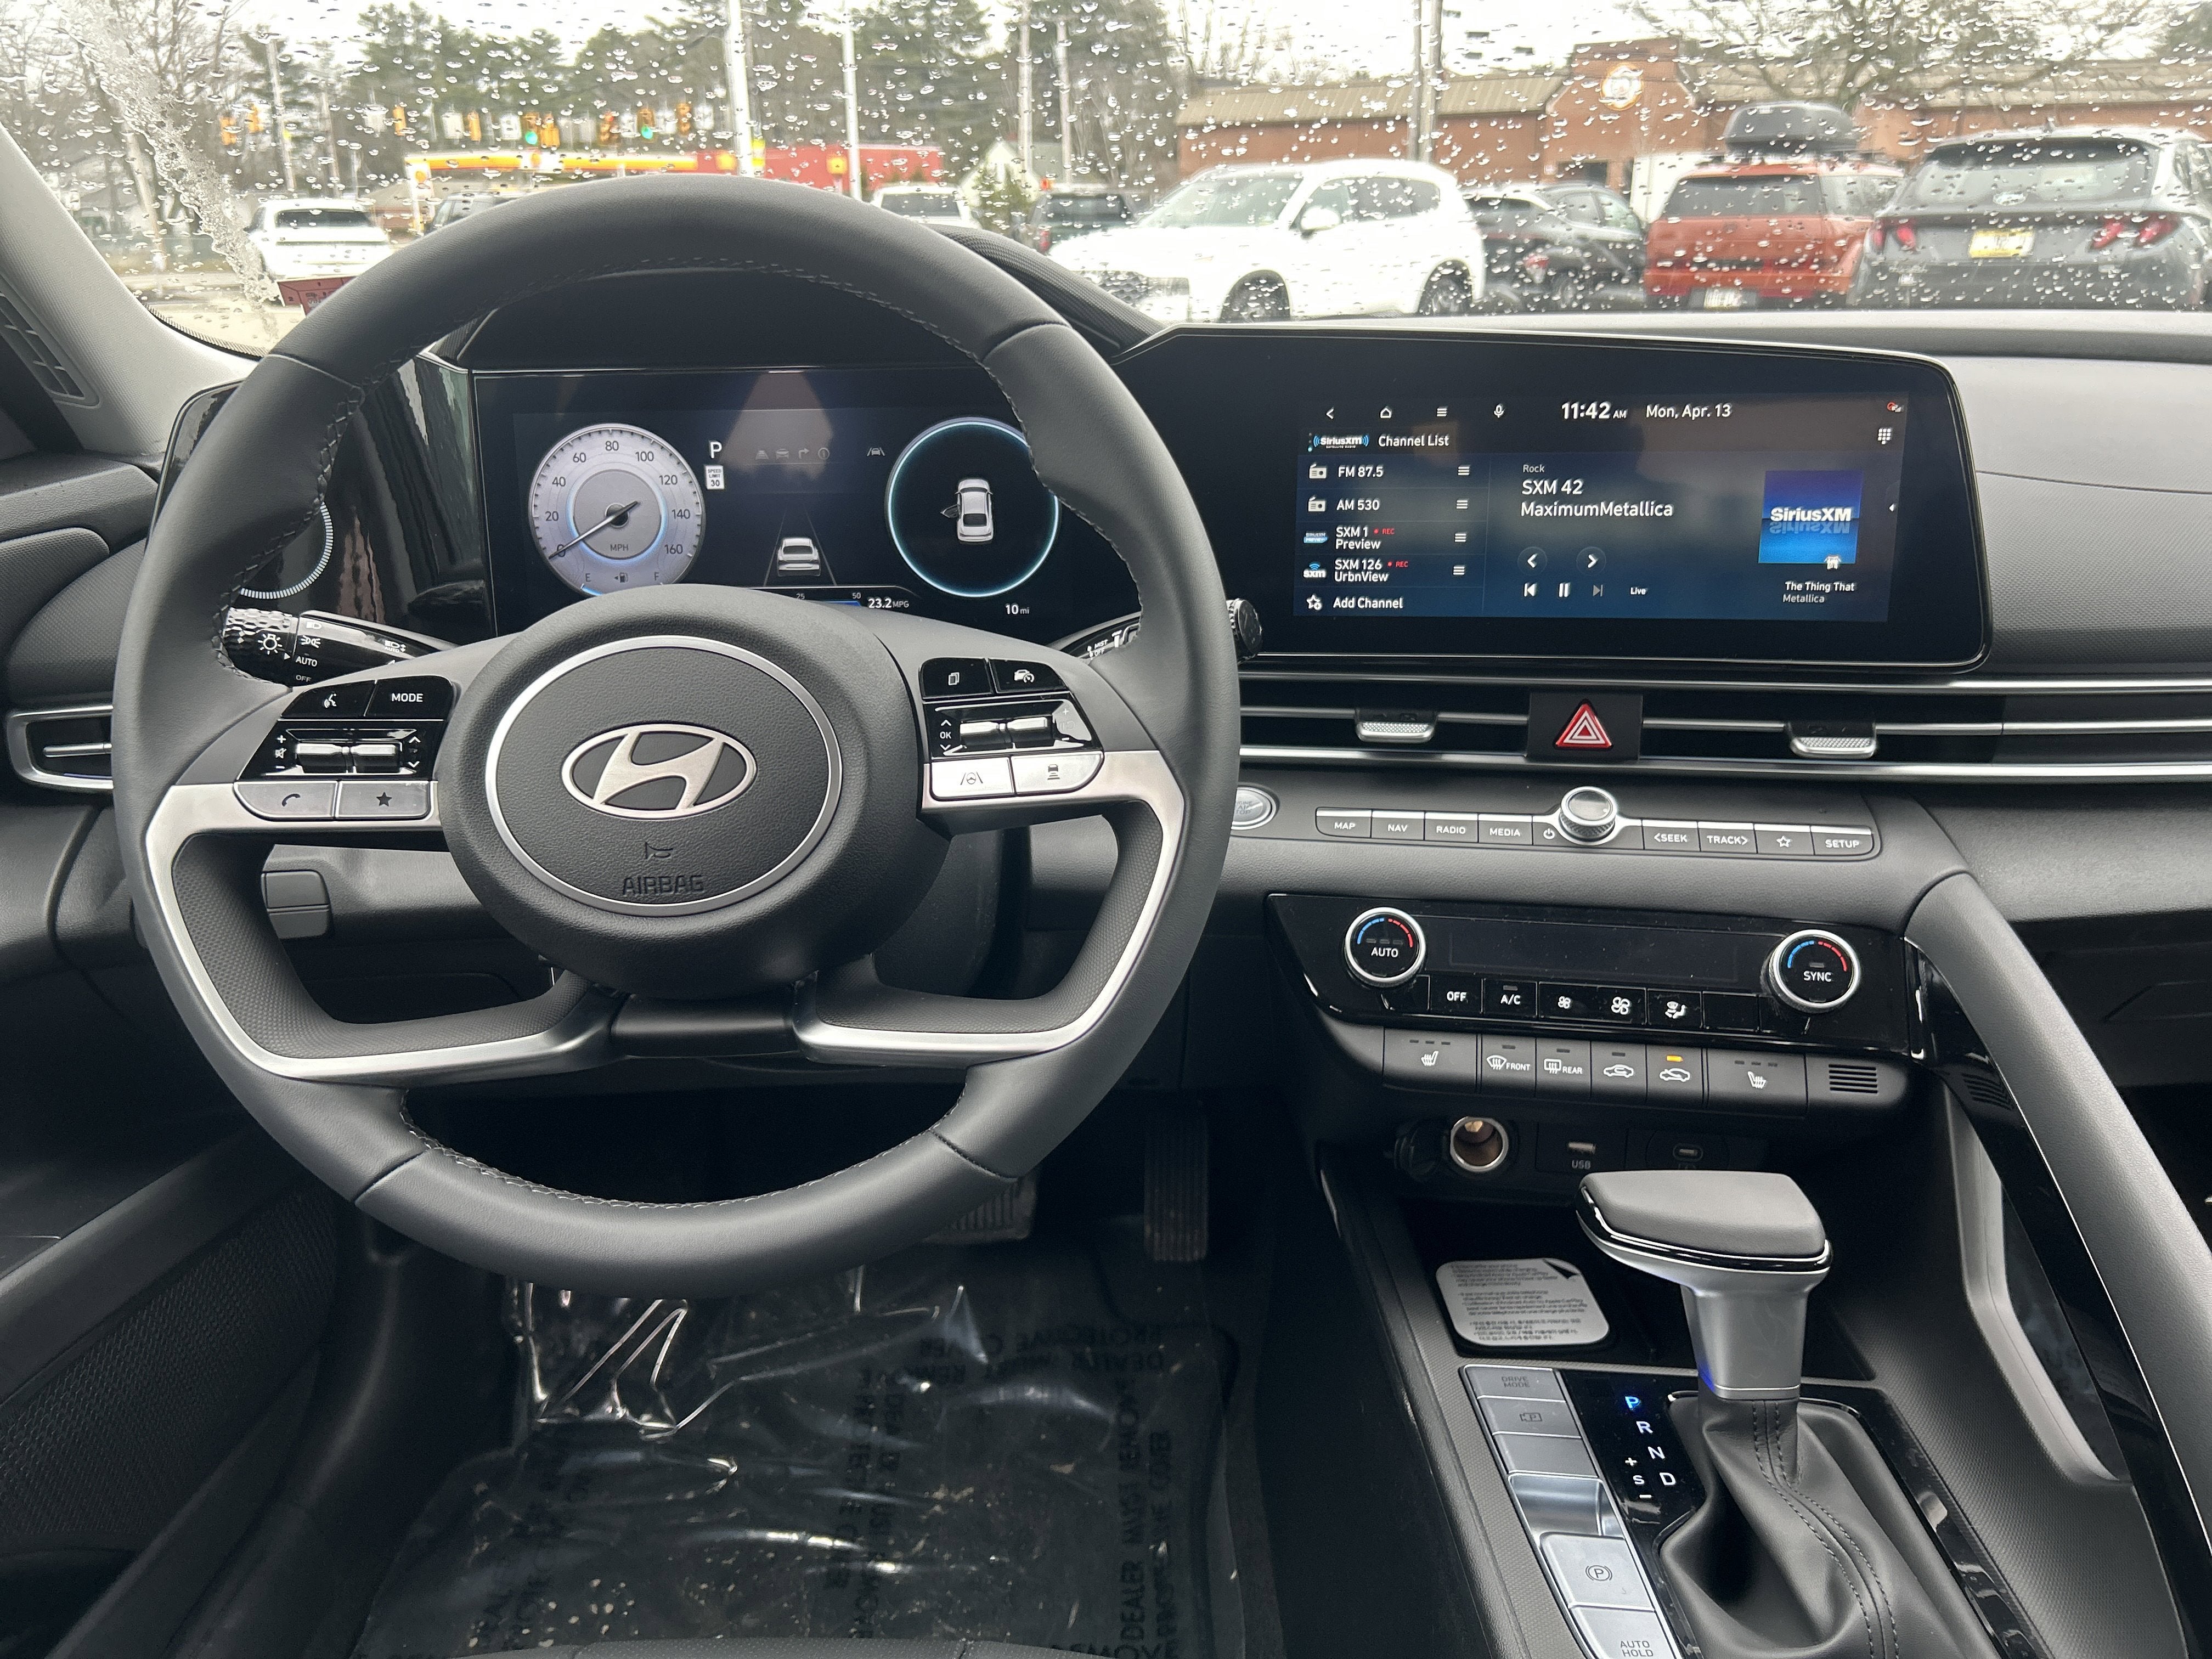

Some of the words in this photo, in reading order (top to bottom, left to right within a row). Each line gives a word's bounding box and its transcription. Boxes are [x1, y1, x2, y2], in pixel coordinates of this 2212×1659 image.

[1561, 402, 1611, 419] 11:42
[1612, 410, 1628, 419] AM
[1646, 404, 1679, 419] Mon,
[1681, 404, 1711, 421] Apr.
[1715, 403, 1733, 417] 13
[605, 441, 619, 452] 80
[1378, 435, 1425, 447] Channel
[1427, 435, 1449, 447] List
[710, 441, 722, 459] P
[572, 452, 586, 463] 60
[635, 451, 654, 462] 100
[1338, 466, 1356, 478] FM
[1357, 466, 1384, 478] 87.5
[1522, 464, 1545, 473] Rock
[552, 476, 566, 487] 40
[659, 475, 678, 486] 120
[1521, 479, 1557, 495] SXM
[1561, 479, 1584, 495] 42
[1336, 499, 1356, 511] AM
[1357, 499, 1380, 511] 530
[1520, 500, 1674, 517] MaximumMetallica
[545, 511, 559, 522] 20
[672, 509, 691, 520] 140
[1770, 507, 1852, 522] SiriusXM
[1335, 527, 1361, 538] SXM
[1362, 527, 1369, 538] 1
[664, 544, 684, 555] 160
[1335, 538, 1381, 550] Preview
[1334, 559, 1359, 571] SXM
[1361, 559, 1382, 571] 126
[585, 573, 591, 583] E
[654, 572, 660, 581] F
[1334, 571, 1389, 583] UrbnView
[1629, 587, 1647, 595] Live
[1785, 580, 1803, 591] The
[1804, 581, 1831, 593] Thing
[1833, 582, 1855, 592] That
[867, 597, 893, 609] 23.2
[892, 600, 910, 608] MPG
[1333, 597, 1356, 609] Add
[1357, 597, 1403, 610] Channel
[1782, 594, 1825, 603] Metallica
[1005, 603, 1019, 615] 10
[1094, 639, 1108, 650] MIST
[1094, 648, 1105, 657] OFF
[295, 656, 318, 667] AUTO
[295, 674, 312, 683] OFF
[391, 692, 424, 703] MODE
[939, 731, 952, 740] OK
[1334, 822, 1356, 831] MAP
[1387, 824, 1408, 833] NAV
[1436, 826, 1466, 835] RADIO
[1489, 828, 1521, 837] MEDIA
[1825, 839, 1860, 849] SETUP
[622, 874, 706, 896] AIRBAG
[1371, 947, 1399, 958] AUTO
[1803, 970, 1832, 983] SYNC
[1446, 991, 1468, 1002] OFF
[1500, 994, 1522, 1005] A/C
[1506, 1062, 1531, 1071] FRONT
[1562, 1066, 1583, 1075] REAR
[1571, 1160, 1592, 1170] USB
[1624, 1396, 1640, 1409] P
[1636, 1420, 1654, 1434] R
[1647, 1446, 1666, 1459] N
[1633, 1475, 1645, 1485] S
[1659, 1472, 1677, 1486] D
[1620, 1640, 1650, 1649] AUTO
[1622, 1648, 1654, 1658] HOLD
